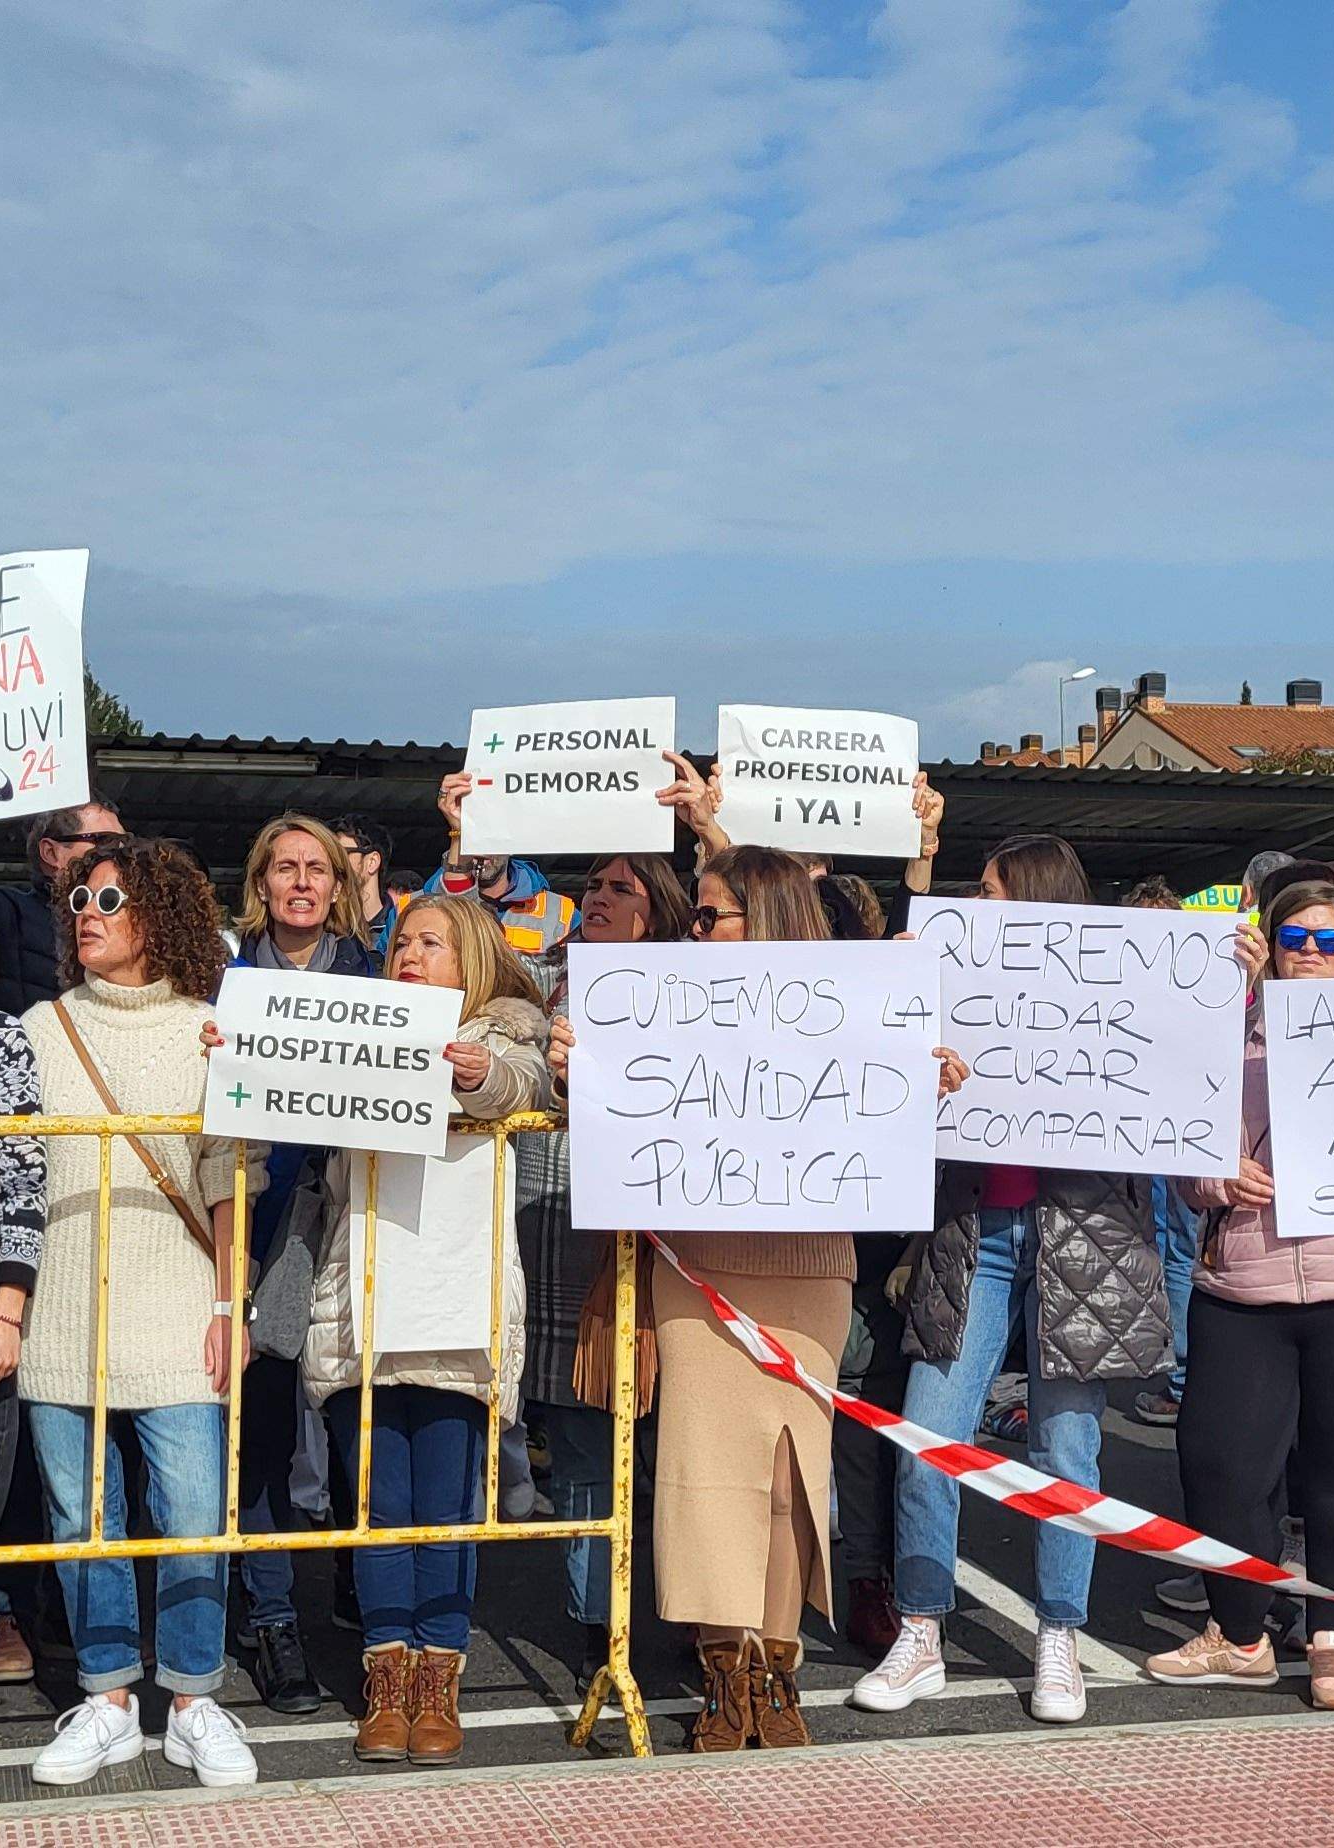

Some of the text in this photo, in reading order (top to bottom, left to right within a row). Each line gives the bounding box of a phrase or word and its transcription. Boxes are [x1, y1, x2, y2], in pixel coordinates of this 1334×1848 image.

[515, 728, 656, 752] PERSONAL
[762, 728, 885, 753] CARRERA
[19, 745, 61, 791] 24
[505, 771, 639, 794] DEMORAS
[735, 760, 909, 786] PROFESIONAL
[796, 798, 841, 825] YA
[919, 909, 1243, 1009] QUEREMOS
[266, 995, 409, 1028] MEJORES
[882, 993, 933, 1031] LA
[235, 1033, 430, 1071] HOSPITALES
[973, 1046, 1150, 1096] CURAR
[266, 1089, 433, 1125] RECURSOS
[936, 1100, 1223, 1161] ACOMPAÑAR
